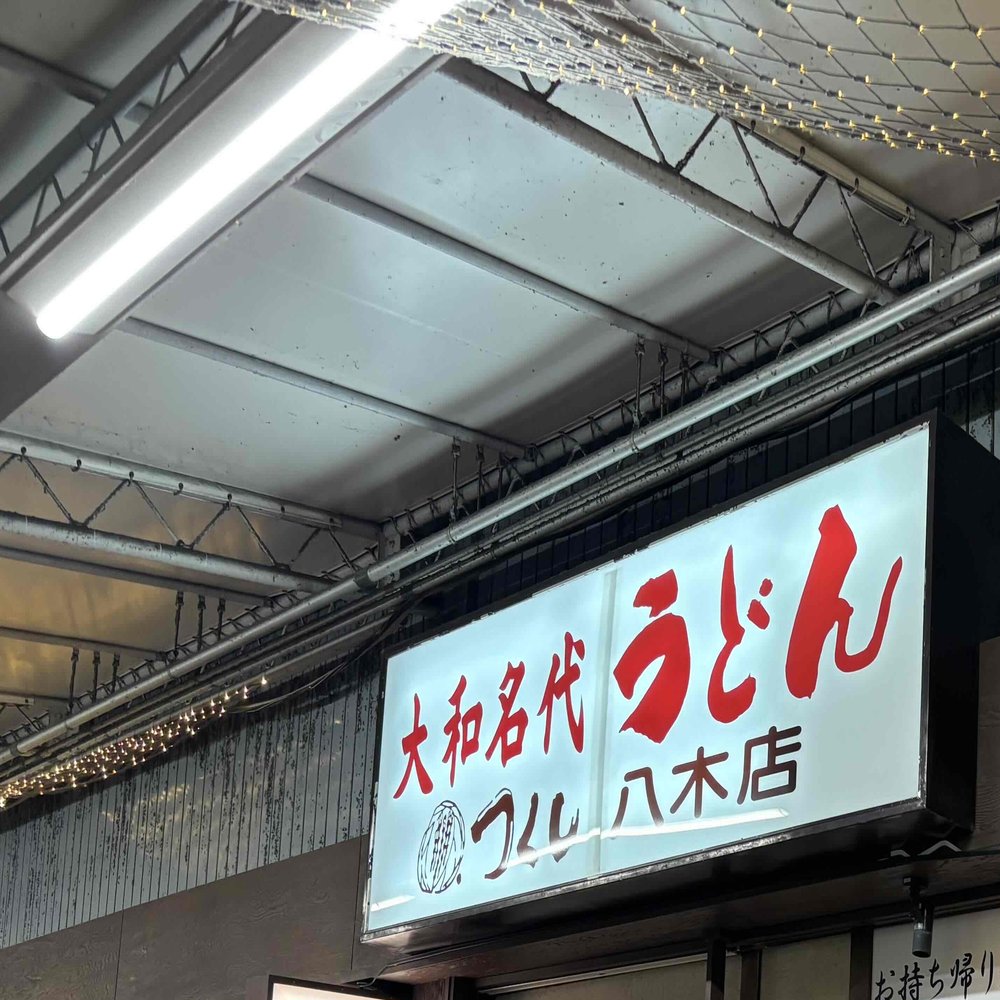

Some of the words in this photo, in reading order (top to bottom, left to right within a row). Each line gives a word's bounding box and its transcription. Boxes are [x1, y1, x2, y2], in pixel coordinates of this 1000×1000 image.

[613, 504, 904, 744] うどん
[393, 631, 586, 799] 大和名代
[613, 725, 802, 840] 八木店
